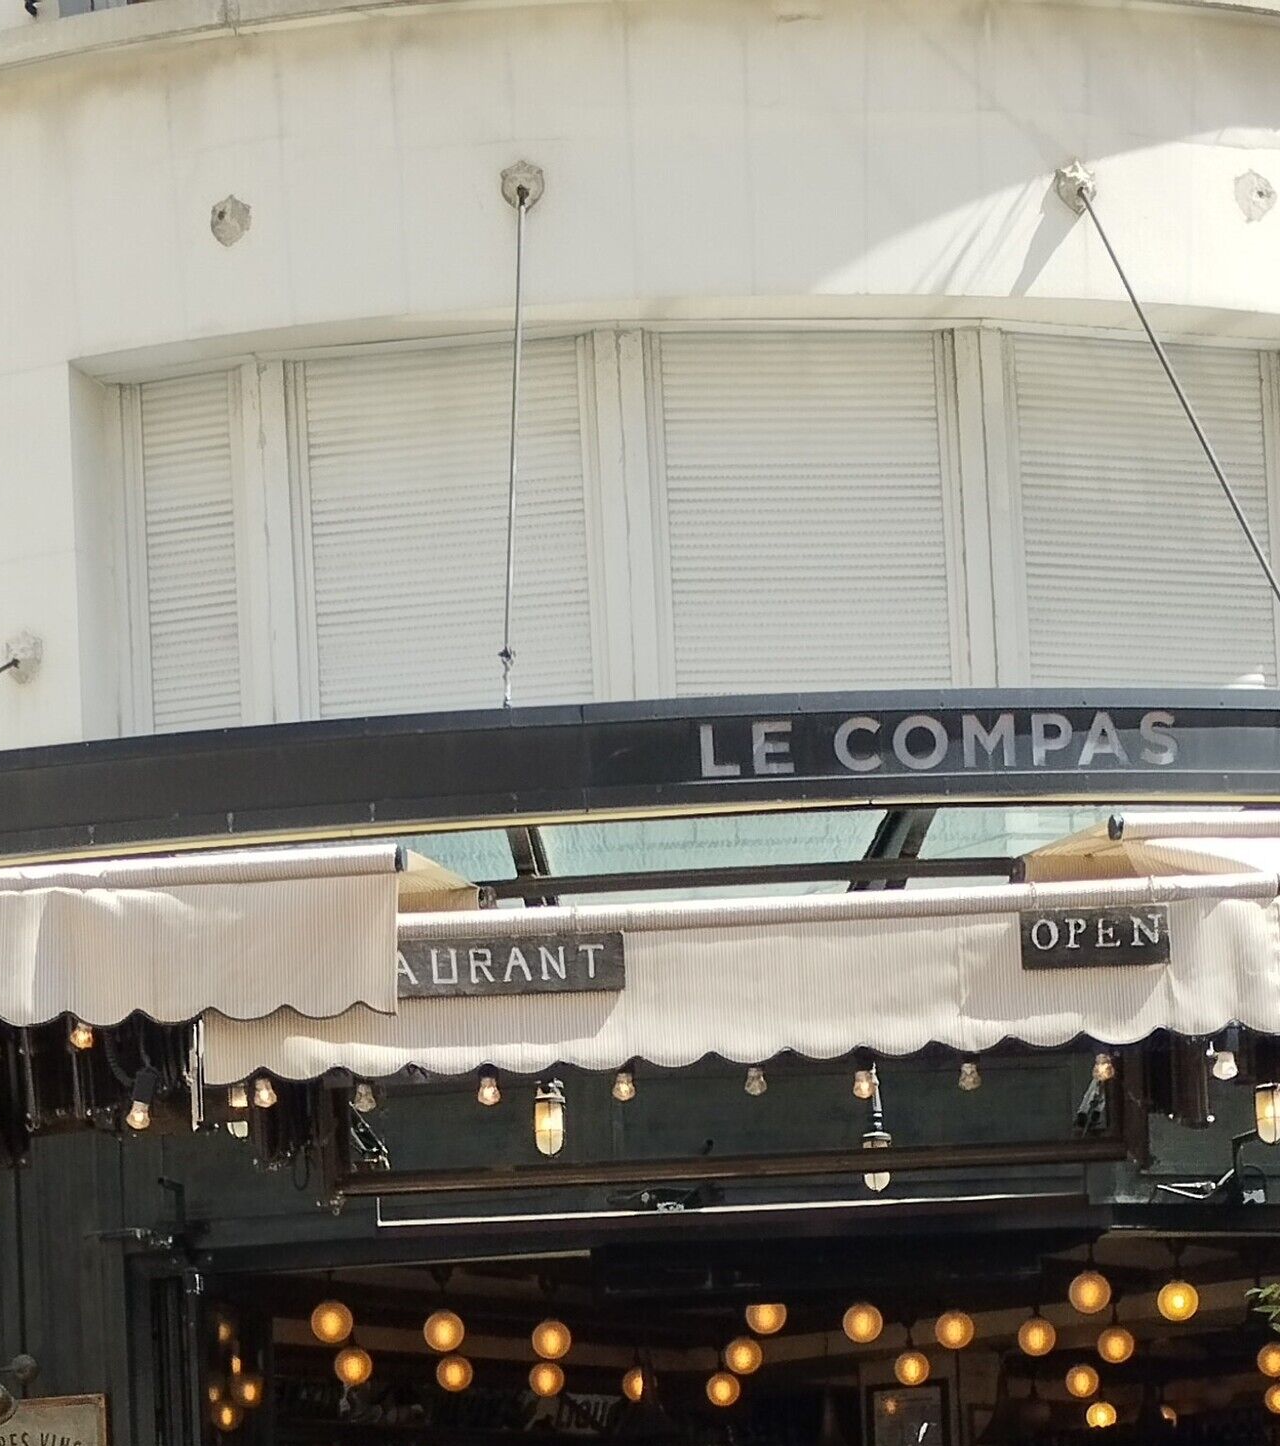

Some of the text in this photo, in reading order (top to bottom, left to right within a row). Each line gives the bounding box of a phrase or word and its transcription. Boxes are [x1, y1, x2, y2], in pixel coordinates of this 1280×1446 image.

[700, 711, 1179, 778] LE COMPAS
[1031, 913, 1162, 951] OPEN
